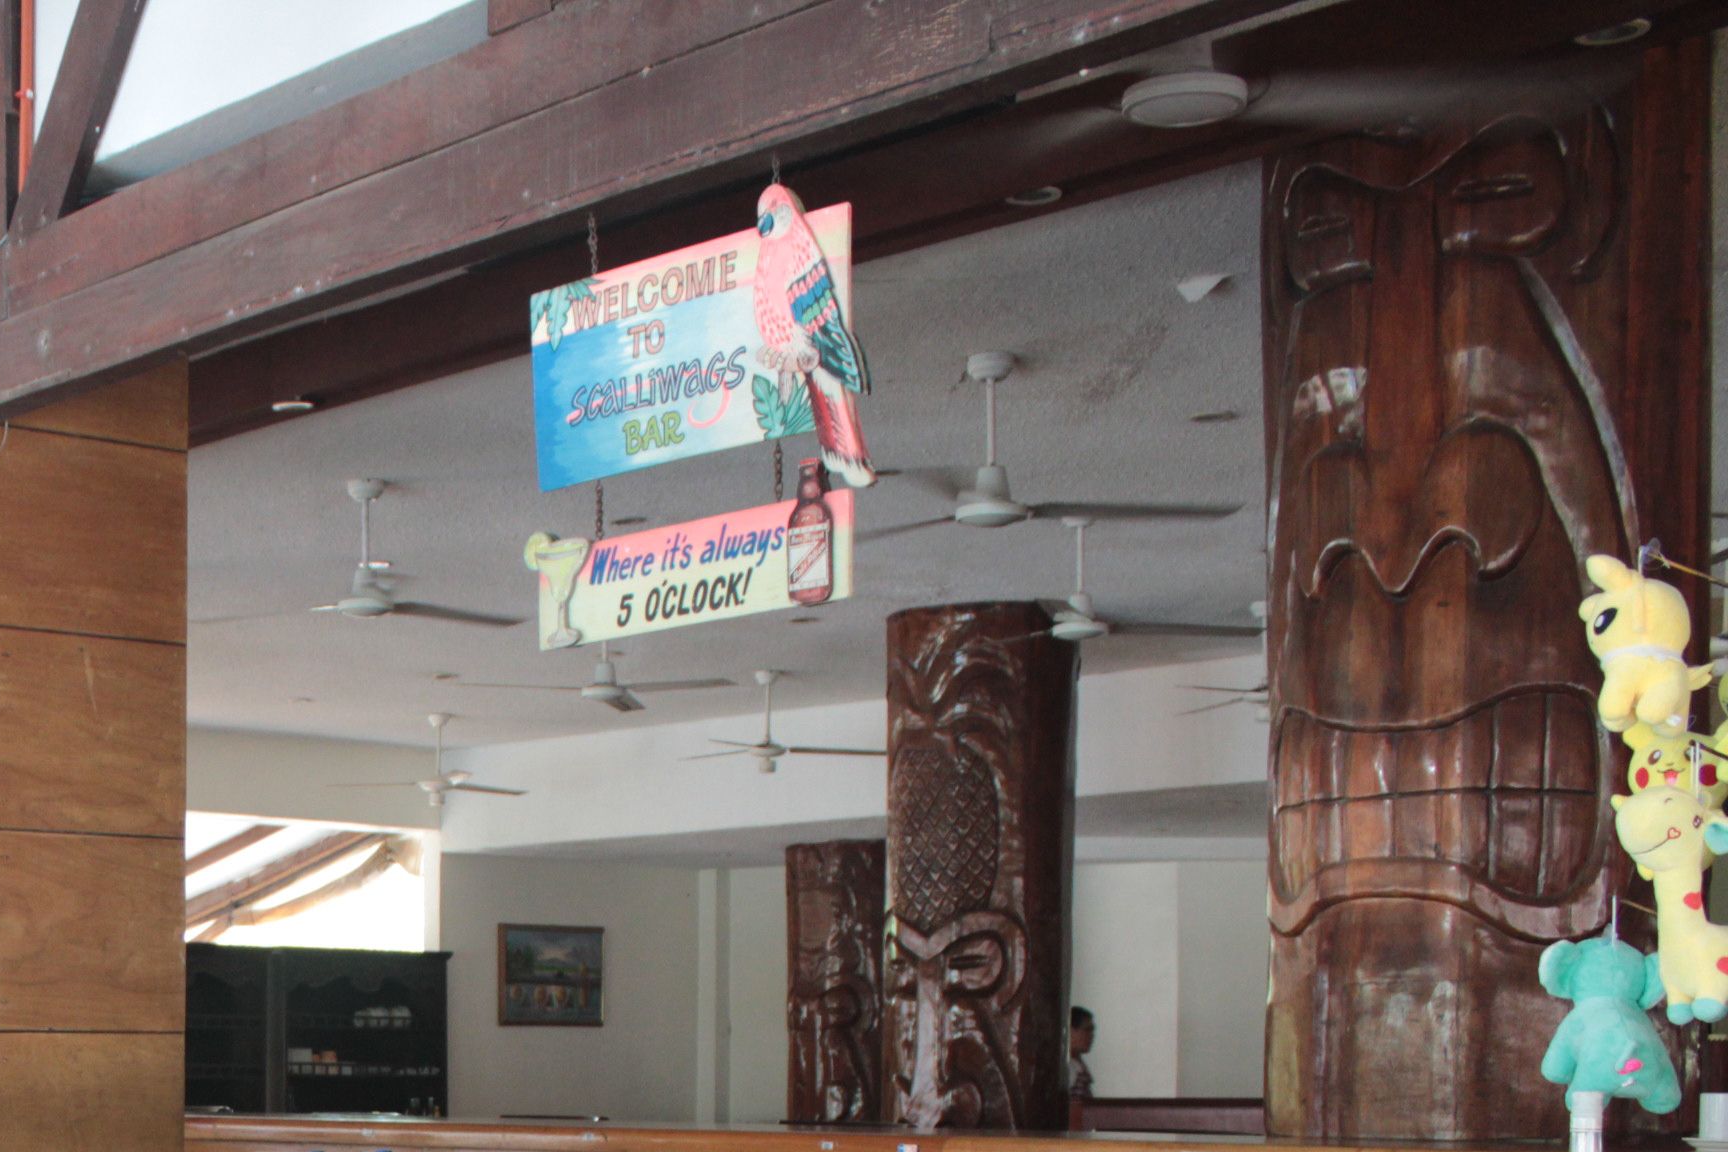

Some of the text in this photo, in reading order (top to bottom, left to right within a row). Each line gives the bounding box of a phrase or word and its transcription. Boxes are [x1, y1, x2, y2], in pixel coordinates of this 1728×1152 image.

[571, 250, 738, 332] WELCOME
[627, 319, 665, 359] TO
[623, 410, 686, 456] BAR
[589, 544, 655, 586] Where
[661, 532, 693, 572] it's
[700, 523, 785, 568] always
[617, 566, 754, 628] 5 O'CLOCK!
